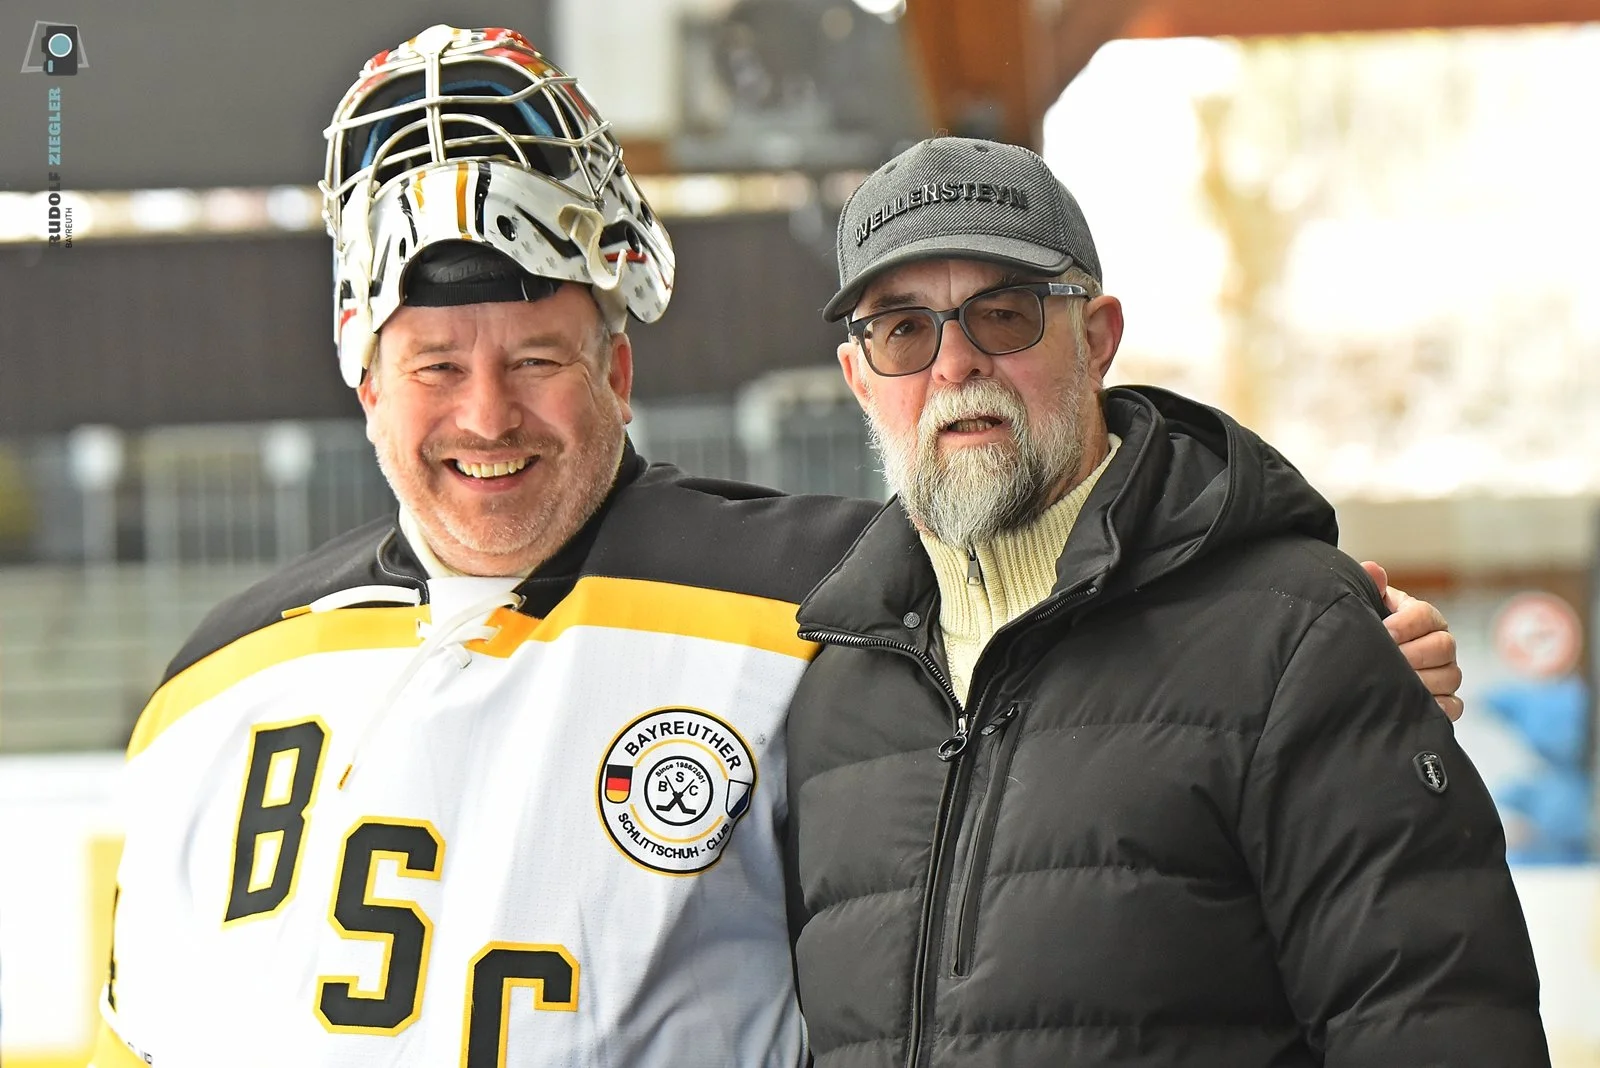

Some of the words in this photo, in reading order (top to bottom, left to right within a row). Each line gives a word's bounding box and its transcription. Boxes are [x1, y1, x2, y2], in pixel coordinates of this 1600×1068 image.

[854, 181, 1028, 247] WELLENSTEYN
[624, 721, 742, 771] BAYREUTHER
[655, 764, 674, 777] Since
[618, 812, 699, 859] SCHLITTSCHUH
[706, 823, 730, 850] CLUB
